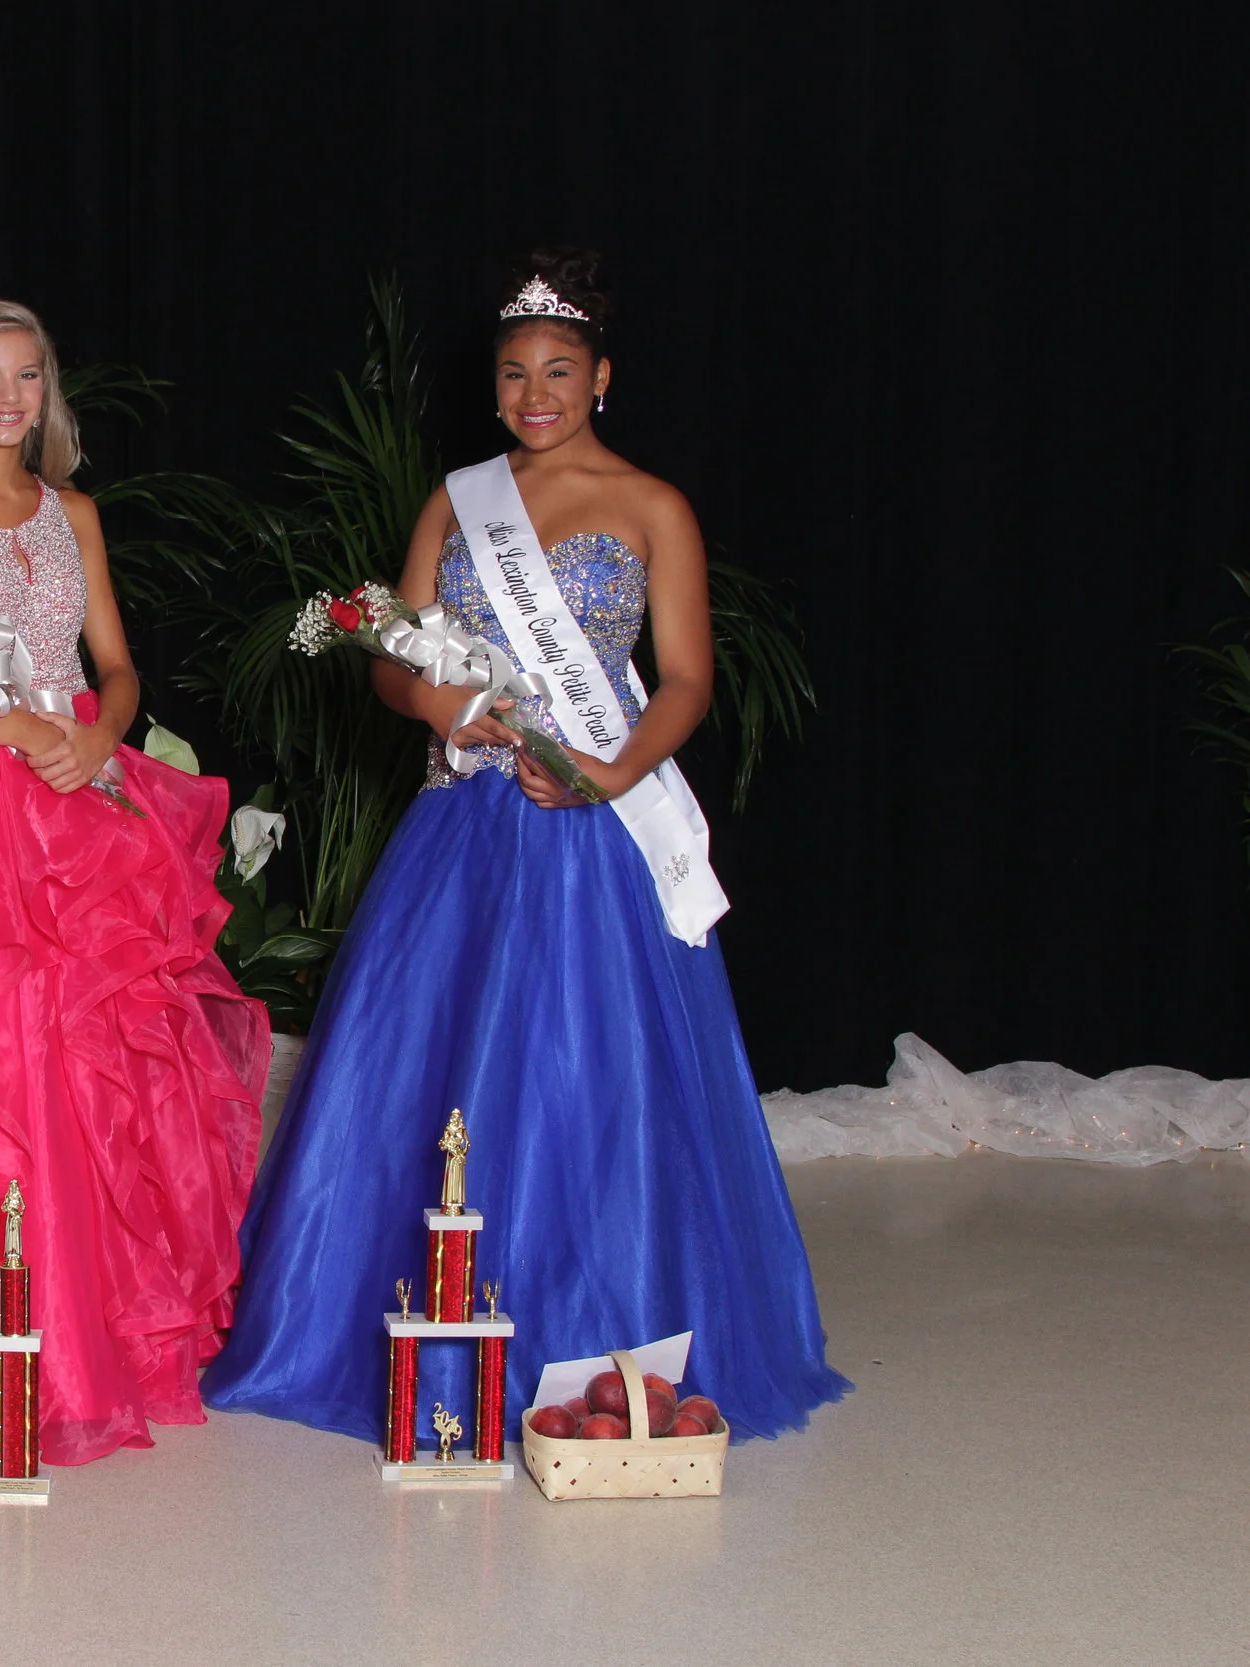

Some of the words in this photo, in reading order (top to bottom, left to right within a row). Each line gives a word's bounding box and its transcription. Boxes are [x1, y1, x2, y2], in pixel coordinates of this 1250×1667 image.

[484, 521, 518, 547] Miss
[495, 547, 538, 617] Lexington
[528, 617, 566, 664] County
[553, 663, 589, 706] Petite
[578, 704, 620, 749] Peach
